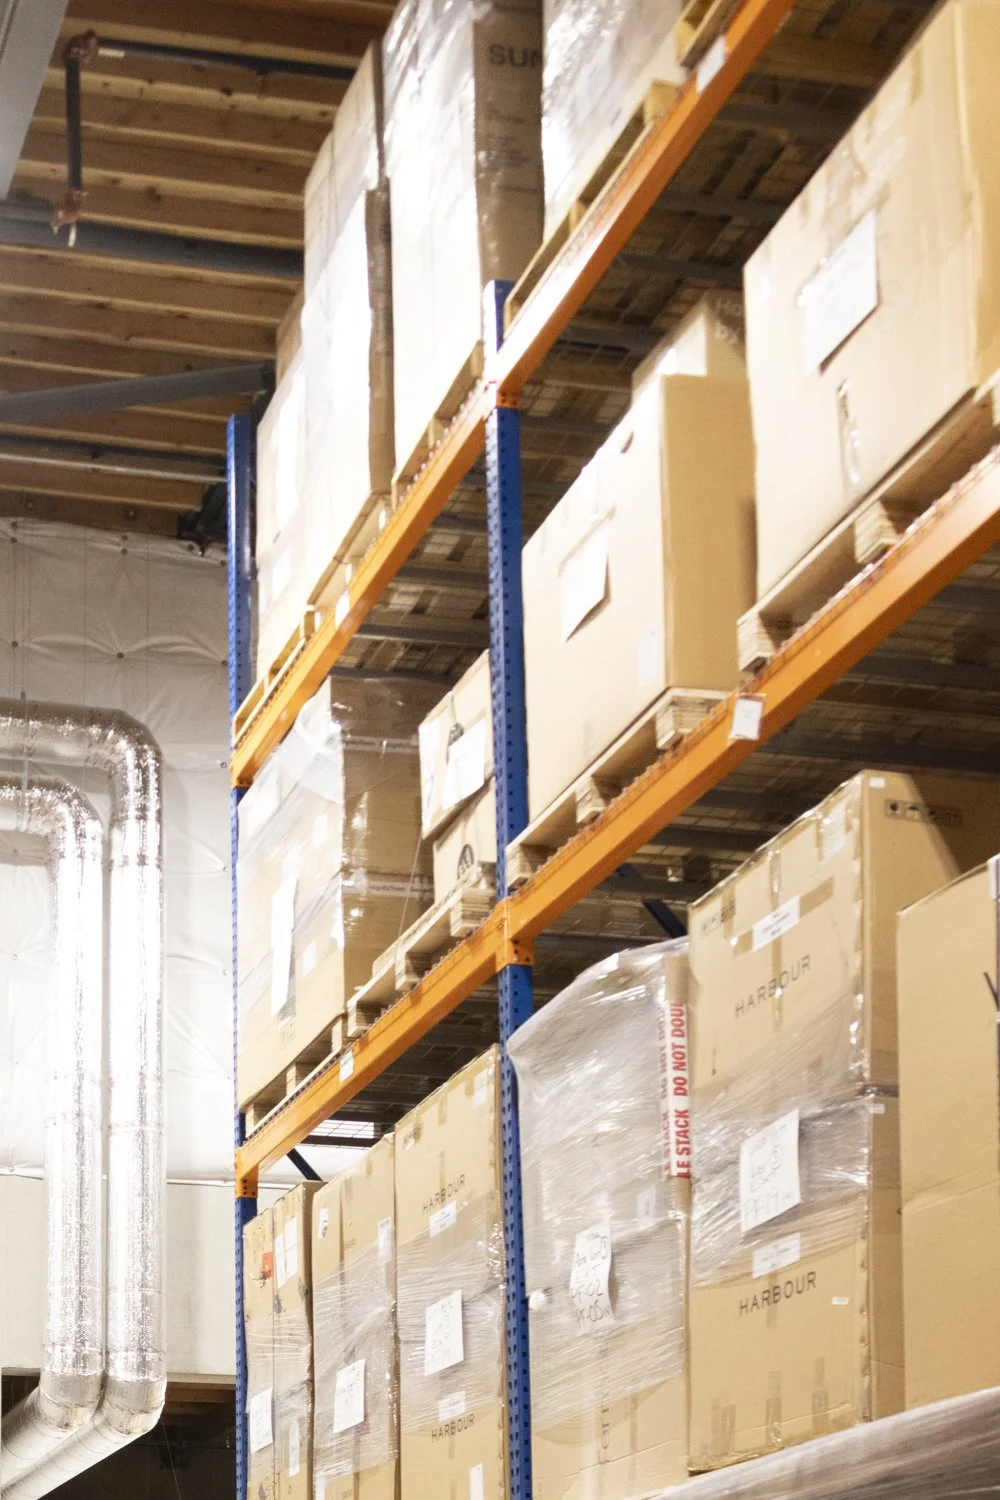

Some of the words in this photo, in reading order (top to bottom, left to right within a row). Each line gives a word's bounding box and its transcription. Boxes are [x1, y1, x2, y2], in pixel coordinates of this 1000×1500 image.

[734, 954, 812, 1019] HARBOUR
[669, 1003, 686, 1039] DOU
[671, 1042, 688, 1073] NOT
[673, 1075, 688, 1097] DO
[674, 1109, 691, 1156] STACK
[422, 1173, 466, 1216] HARBOUR
[738, 1270, 818, 1317] HARBOUR
[430, 1412, 476, 1444] HARBOUR
